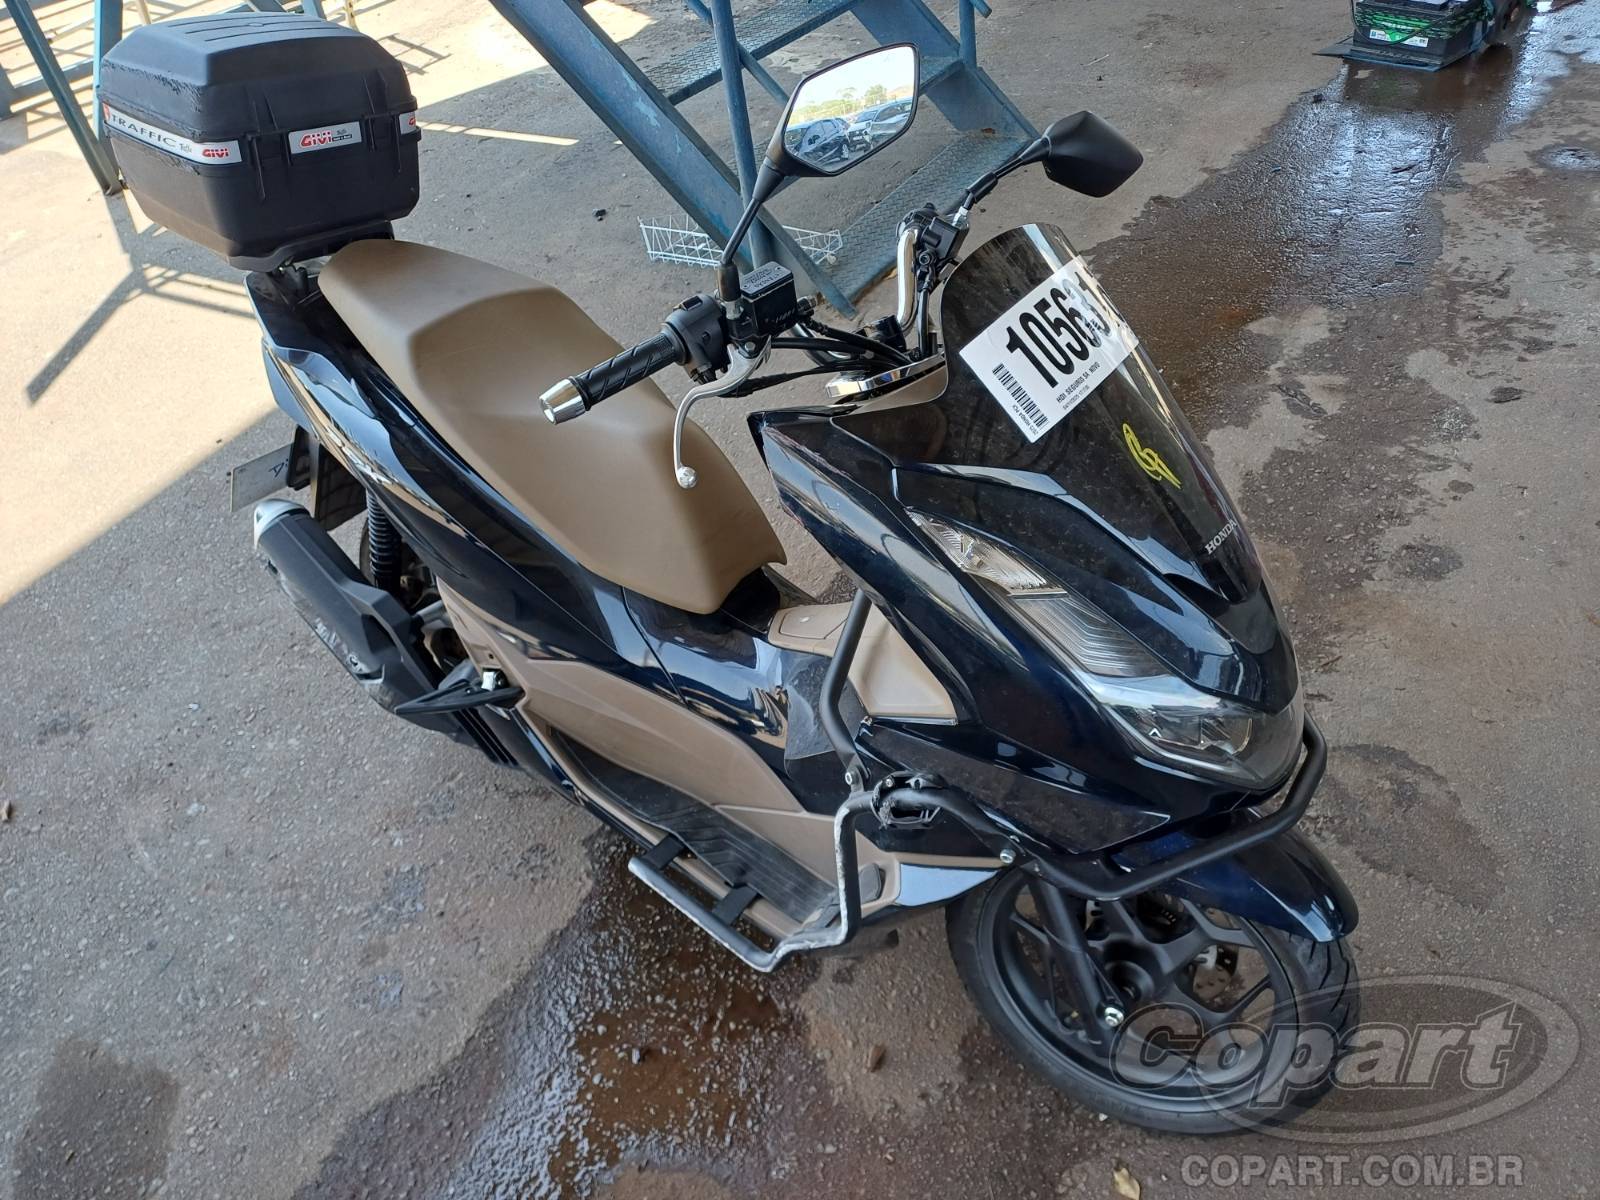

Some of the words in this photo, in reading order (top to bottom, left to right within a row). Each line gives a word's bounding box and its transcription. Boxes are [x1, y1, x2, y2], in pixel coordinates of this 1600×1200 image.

[111, 114, 177, 148] TRAFFIC
[300, 131, 332, 149] GIVI
[202, 147, 230, 159] GIVI
[1204, 518, 1238, 555] HONDA
